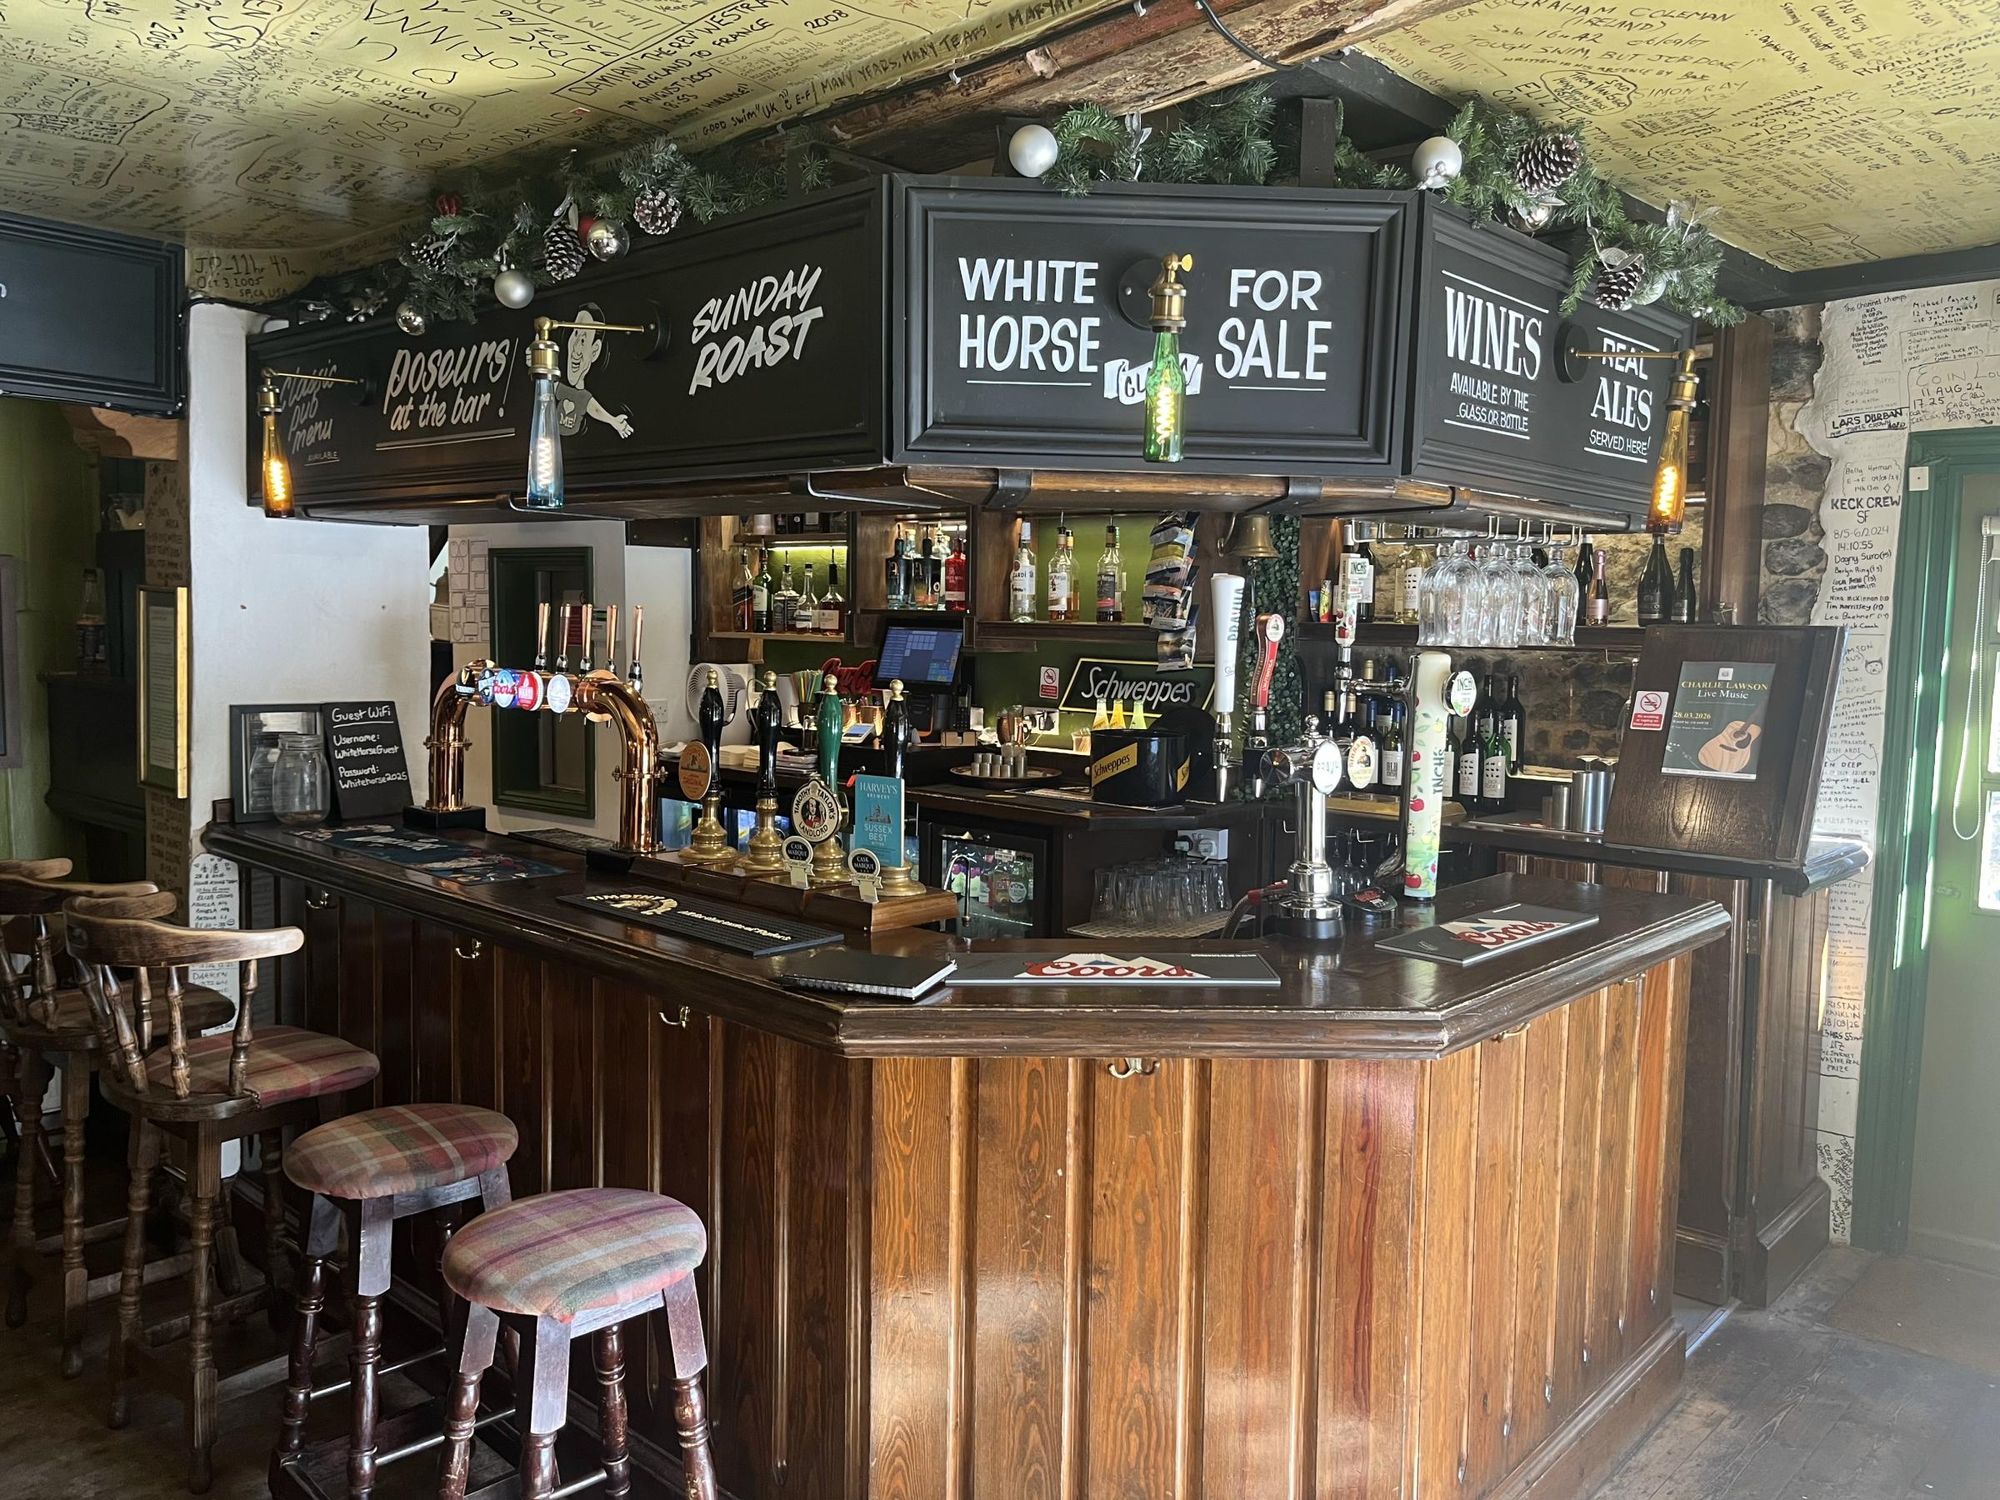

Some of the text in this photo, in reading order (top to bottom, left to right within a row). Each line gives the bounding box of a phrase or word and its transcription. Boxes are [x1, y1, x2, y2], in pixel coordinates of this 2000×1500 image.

[1629, 6, 1736, 23] COLEMAN
[632, 58, 693, 89] ENGLAND
[690, 50, 712, 60] TO
[712, 17, 774, 49] FRANCE
[702, 119, 728, 136] GOOD
[958, 257, 1099, 304] WHITE
[1229, 269, 1323, 312] FOR
[691, 263, 823, 345] SUNDAY
[959, 313, 1101, 373] HORSE
[1444, 286, 1543, 382] WINES
[688, 305, 824, 396] ROAST
[1215, 317, 1333, 381] SALE
[1601, 337, 1650, 381] REAL
[383, 337, 511, 415] poseurs
[1449, 371, 1530, 413] AVAILABLE BY THE
[1936, 384, 1963, 397] AUG
[390, 403, 414, 432] at
[416, 393, 450, 430] the
[1458, 402, 1530, 433] GLASS OR BOTTLE
[1590, 377, 1653, 433] ALES
[1832, 415, 1861, 430] LARS
[291, 418, 334, 456] menu
[1589, 428, 1625, 453] SERVED
[1831, 494, 1902, 511] KECK CREW
[1856, 509, 1871, 525] SF
[1081, 666, 1196, 711] Schweppes
[1681, 680, 1769, 691] CHARLIE LAWSON
[1697, 689, 1750, 700] Live Music
[331, 705, 392, 723] Guest WiFi
[1093, 753, 1131, 779] Schweppes
[860, 781, 899, 795] HARVEY'S
[794, 788, 836, 821] TIMOTHY TAYLOR'S
[799, 821, 829, 838] LANDLORD
[864, 823, 893, 835] SUSSEX
[868, 832, 888, 843] BEST
[1455, 919, 1561, 945] Coors
[1023, 961, 1197, 978] Coors
